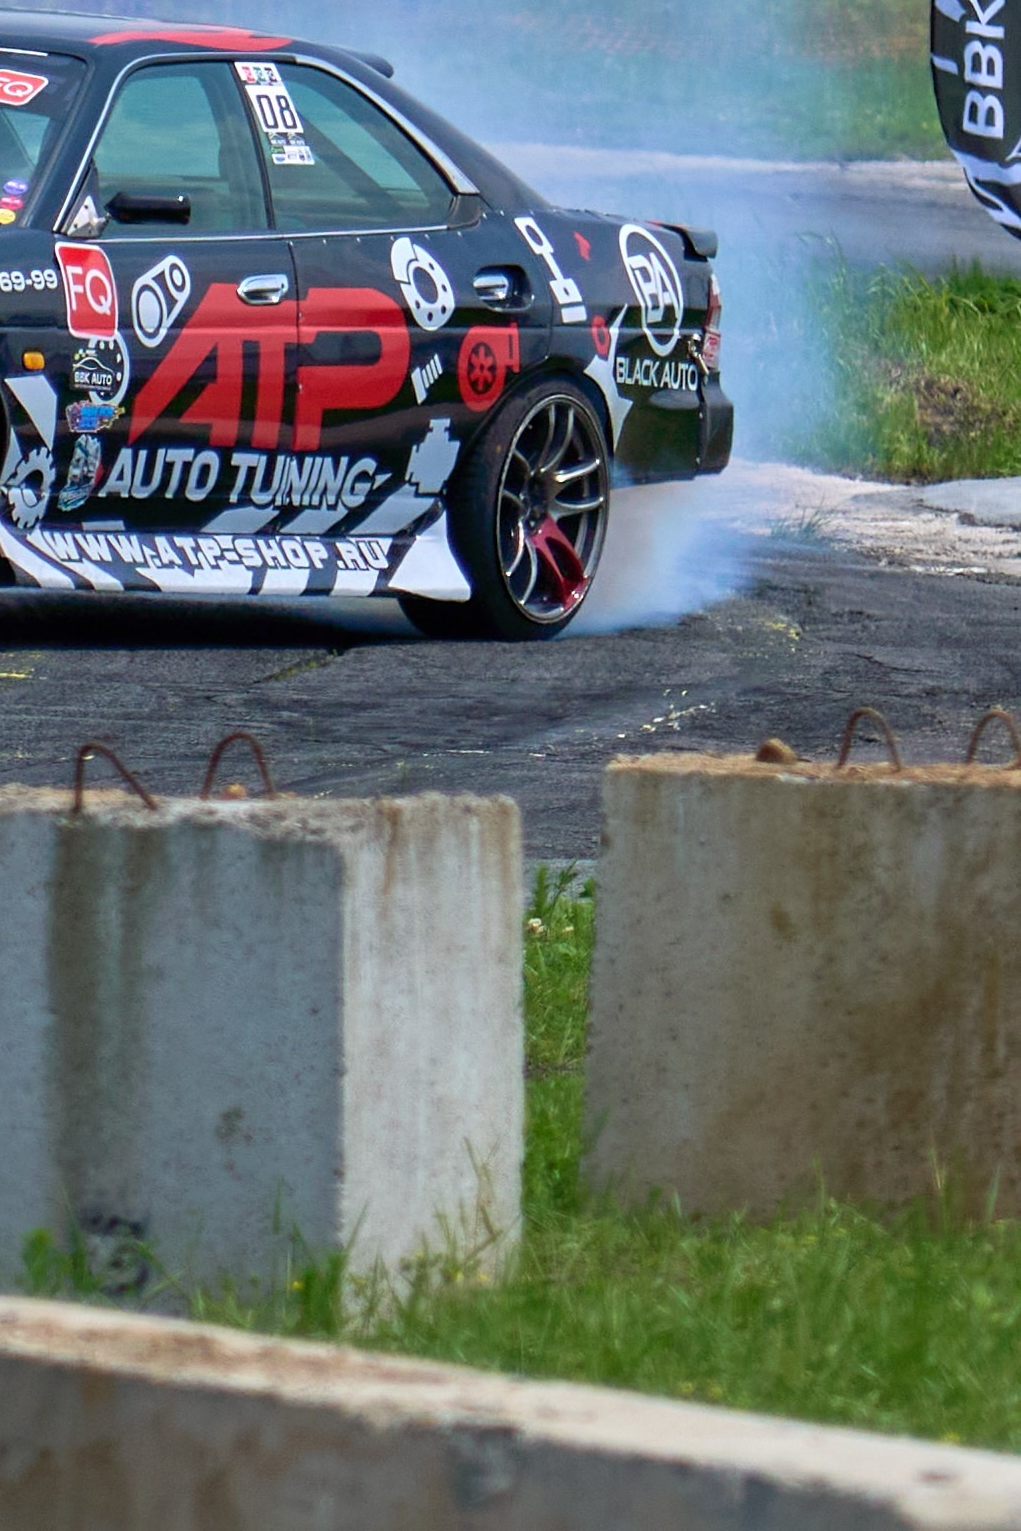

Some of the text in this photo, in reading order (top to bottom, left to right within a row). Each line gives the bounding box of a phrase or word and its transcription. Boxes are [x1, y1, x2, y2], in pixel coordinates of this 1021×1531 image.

[256, 94, 298, 129] 08
[65, 265, 113, 316] FQ
[91, 372, 113, 385] AUTO
[616, 356, 698, 391] BLACK AUTO
[97, 447, 378, 510] AUTO TUNING
